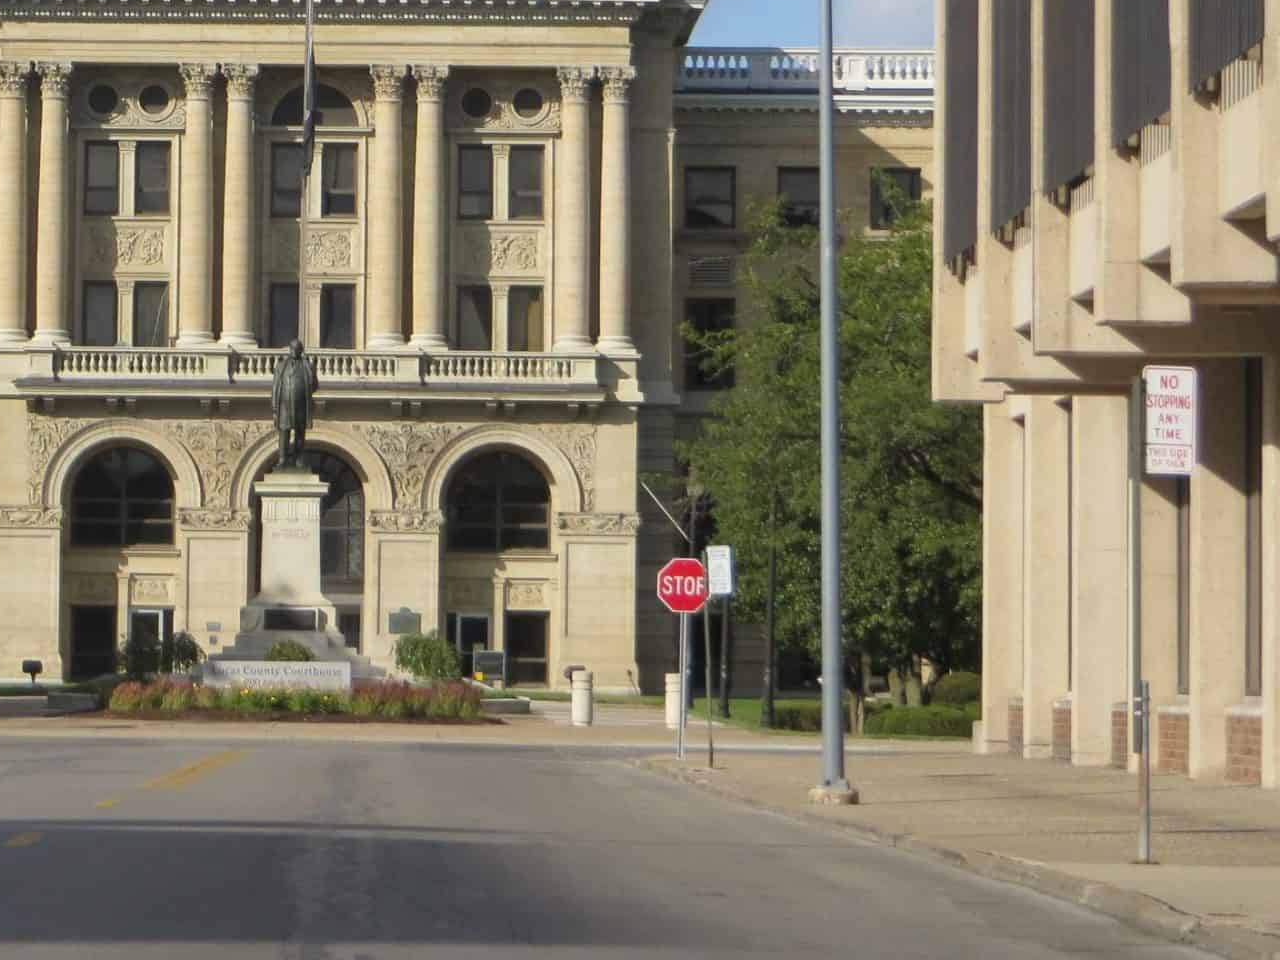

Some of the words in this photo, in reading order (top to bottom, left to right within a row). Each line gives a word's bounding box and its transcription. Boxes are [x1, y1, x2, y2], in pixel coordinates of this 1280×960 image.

[1160, 375, 1178, 390] NO
[1145, 393, 1191, 410] STOPPING
[1159, 413, 1182, 425] ANY
[1152, 427, 1184, 441] TIME
[243, 665, 280, 677] County
[283, 665, 342, 676] Courthouse
